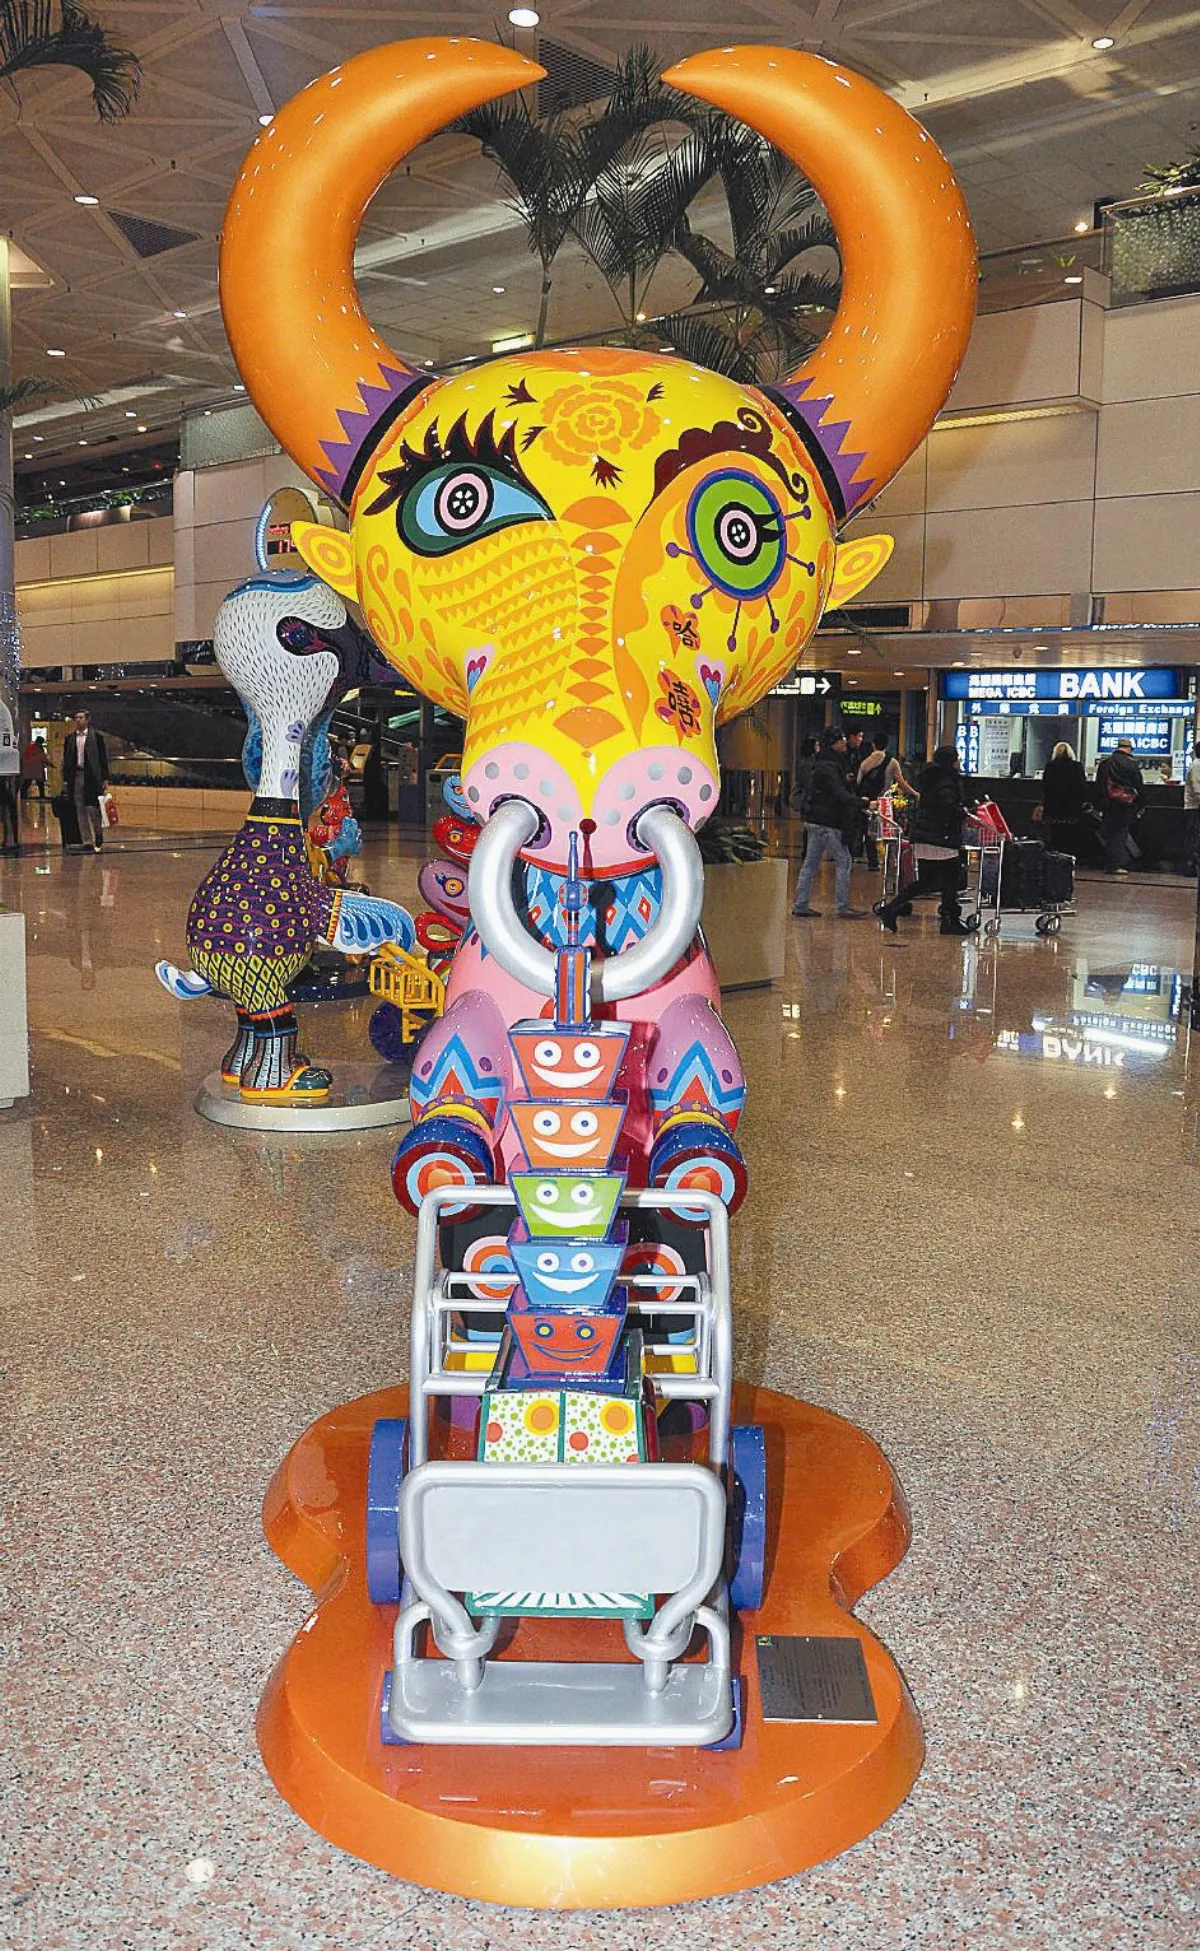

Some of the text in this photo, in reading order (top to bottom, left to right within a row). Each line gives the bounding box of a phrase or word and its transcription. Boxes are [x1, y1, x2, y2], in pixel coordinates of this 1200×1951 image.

[1059, 672, 1146, 698] BANK
[1089, 703, 1134, 716] Foreign
[969, 725, 979, 772] BANK
[1100, 736, 1169, 749] MEA ICBC
